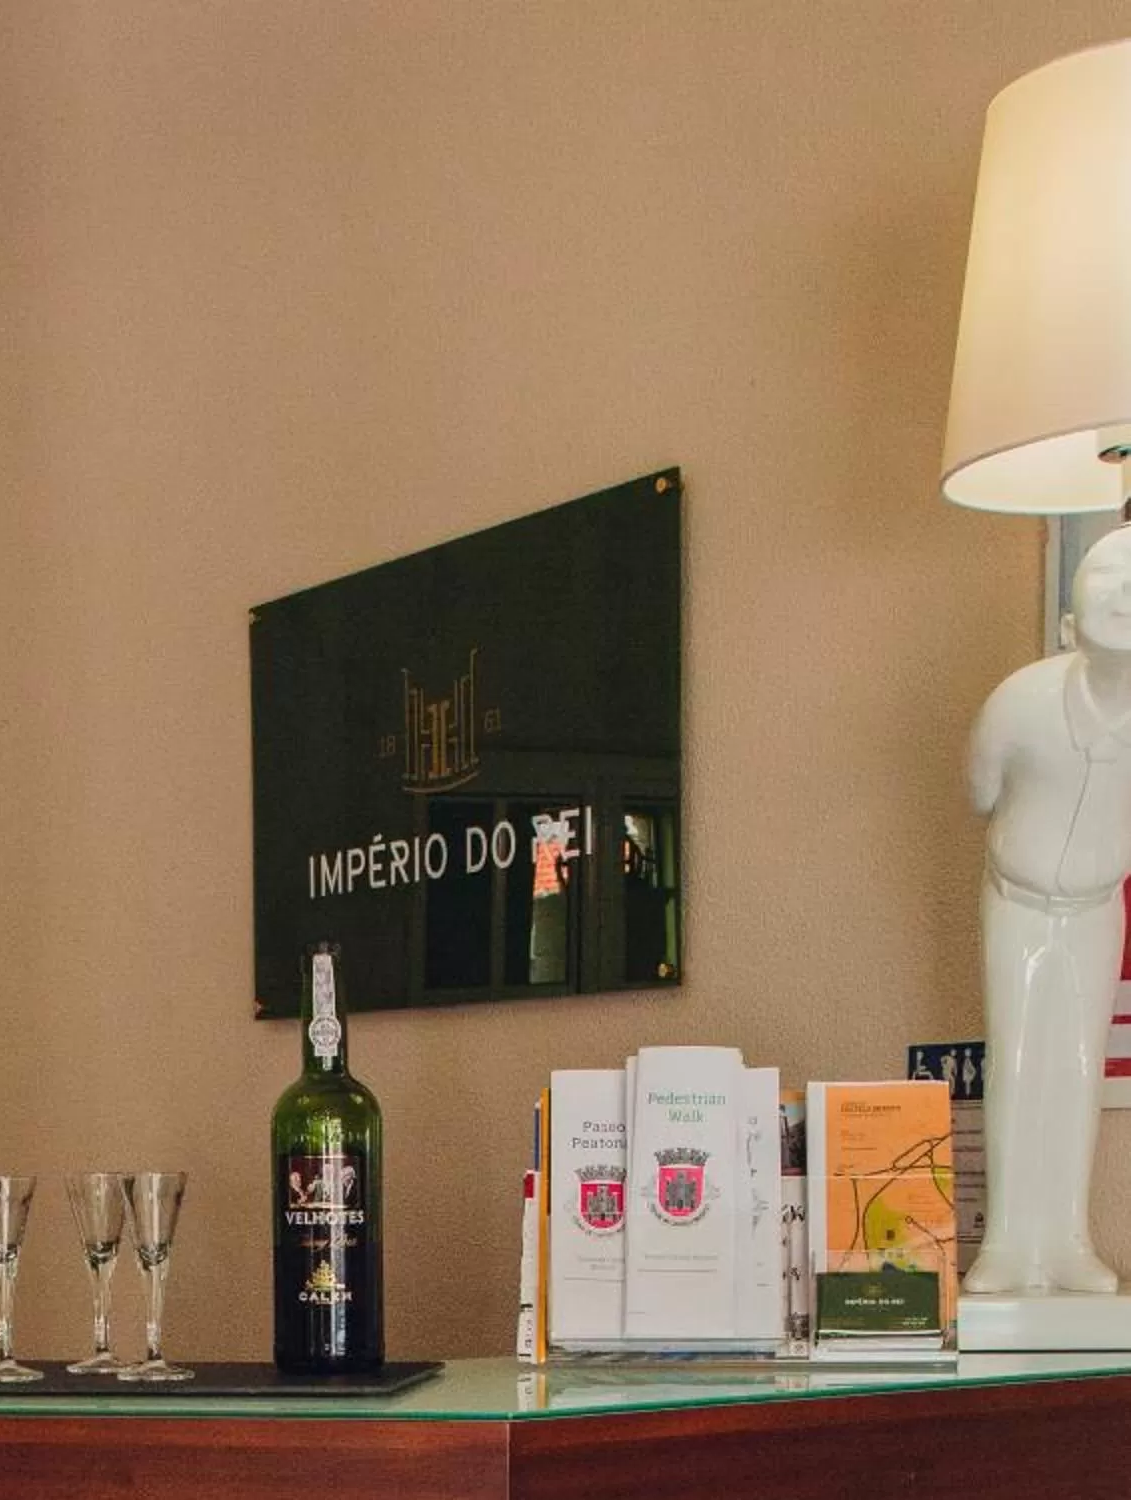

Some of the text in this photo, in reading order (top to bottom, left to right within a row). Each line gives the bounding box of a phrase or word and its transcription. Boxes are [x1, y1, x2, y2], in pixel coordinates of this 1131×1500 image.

[309, 805, 592, 899] IMPÉRIO DO REI
[648, 1092, 726, 1105] Pedestrian
[668, 1110, 704, 1122] Walk
[572, 1137, 628, 1149] Peaton
[285, 1210, 364, 1225] VELHOTES
